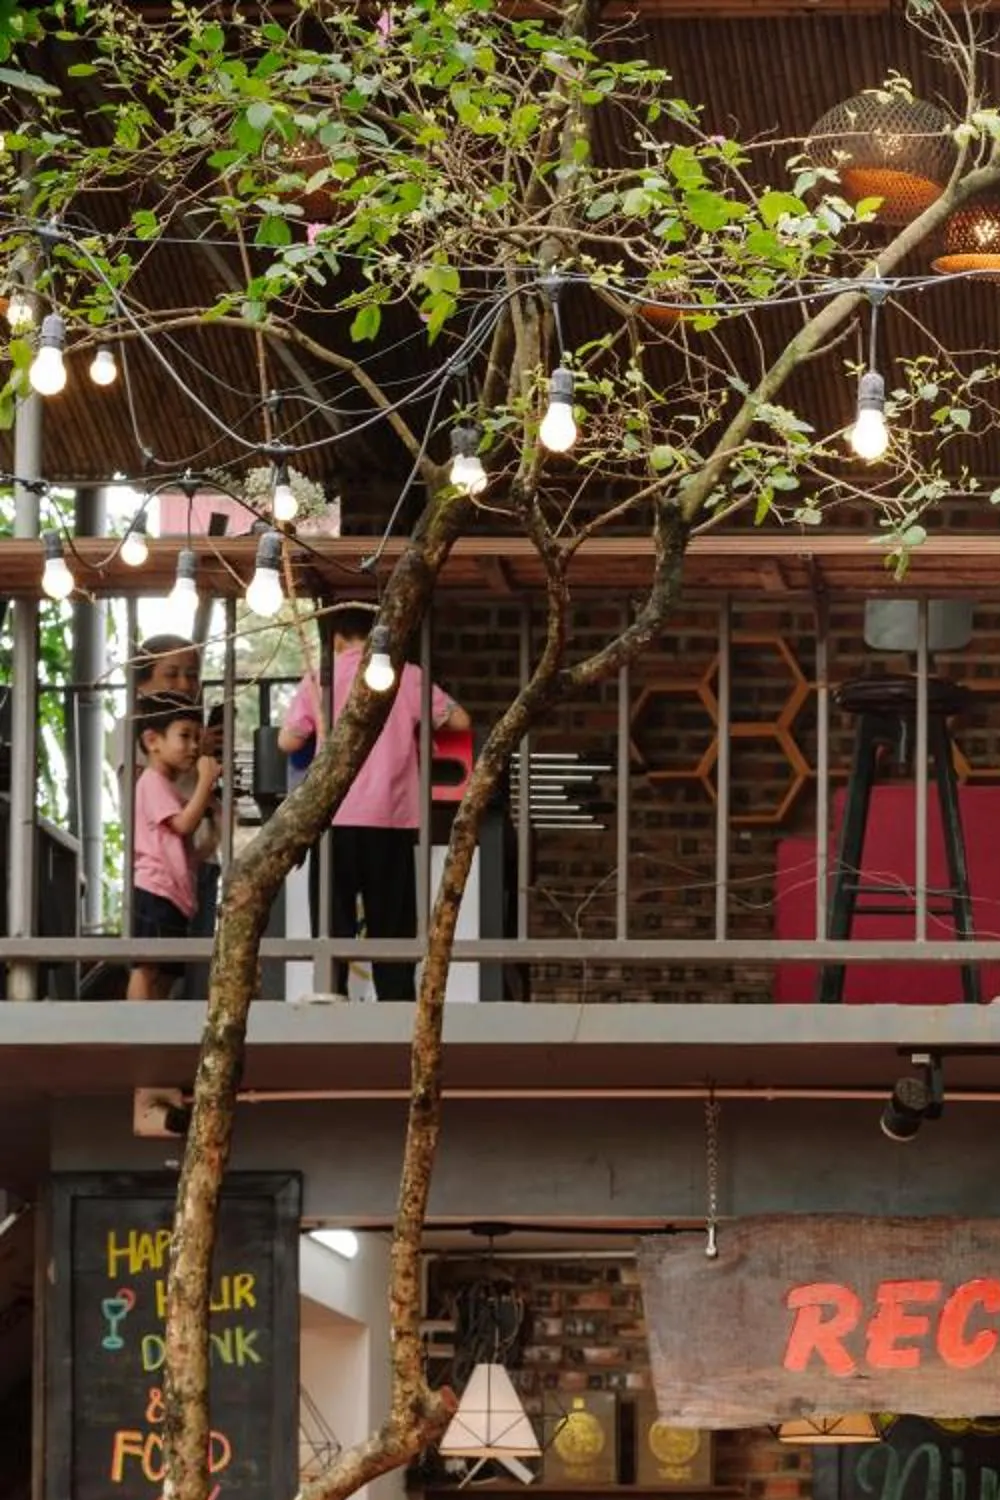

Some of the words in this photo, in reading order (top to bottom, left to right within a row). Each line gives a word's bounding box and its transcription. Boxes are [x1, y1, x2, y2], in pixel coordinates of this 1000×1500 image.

[108, 1229, 171, 1278] HAP
[155, 1272, 257, 1318] HUR
[141, 1326, 261, 1371] DNK
[146, 1387, 166, 1422] &
[111, 1430, 231, 1481] FOD
